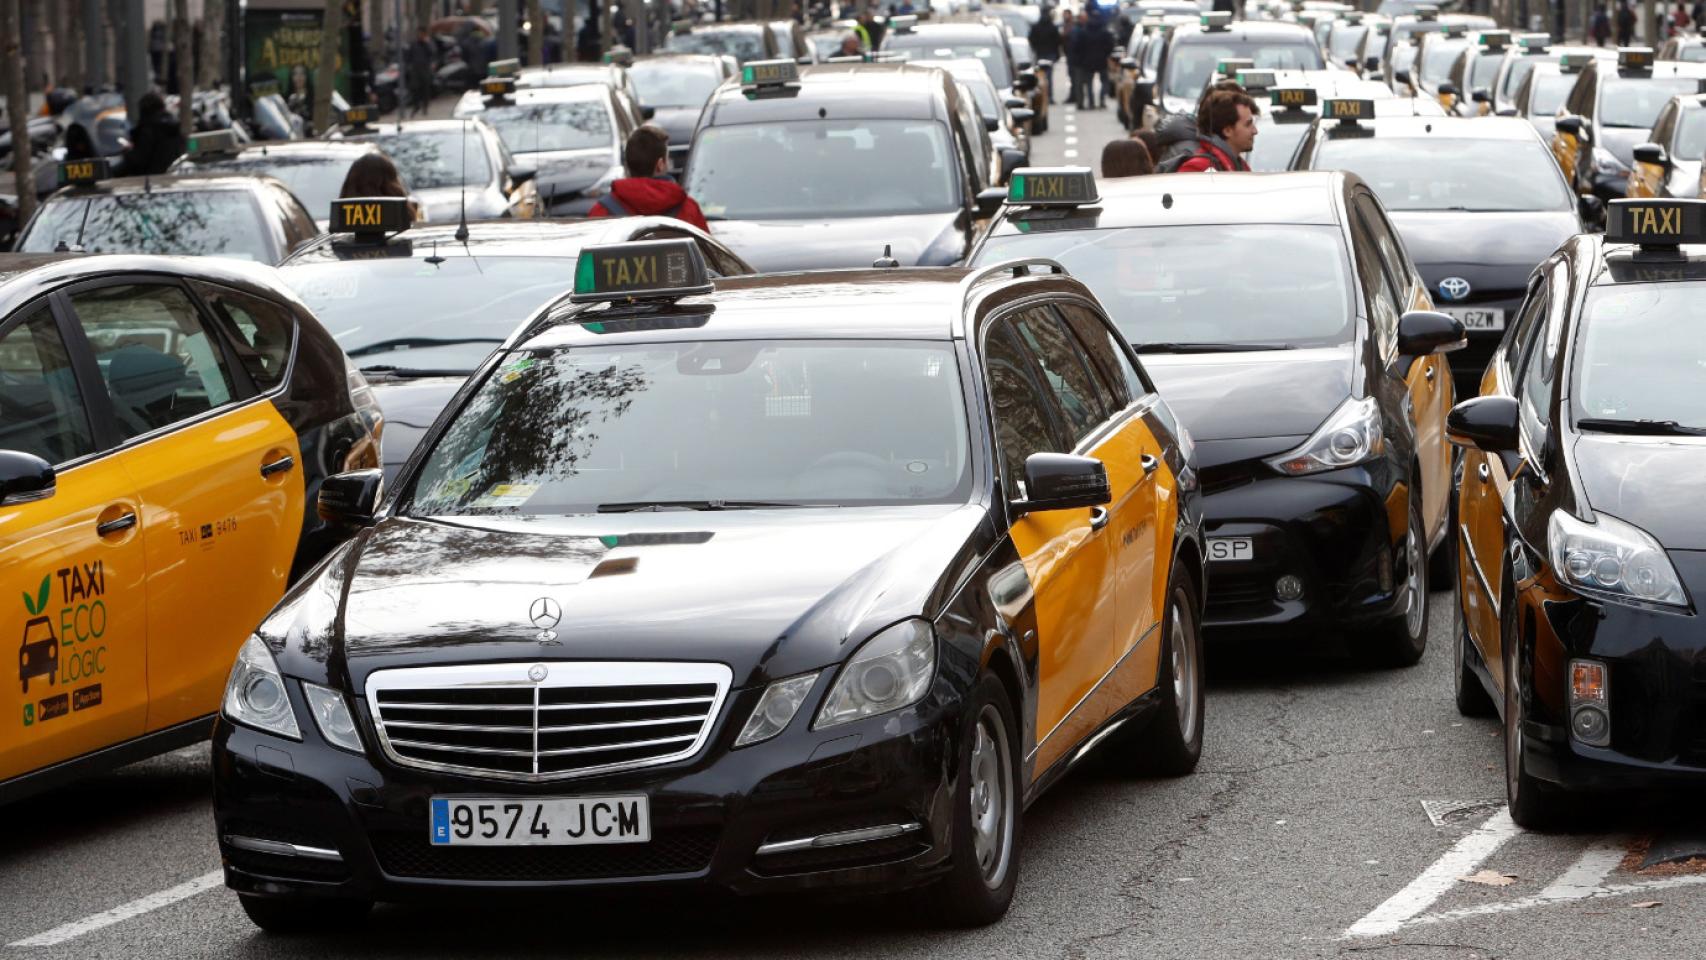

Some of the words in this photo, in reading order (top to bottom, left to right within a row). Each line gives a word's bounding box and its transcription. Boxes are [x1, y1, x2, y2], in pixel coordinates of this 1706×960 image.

[1280, 91, 1304, 103] TAXI
[1332, 102, 1360, 115] TAXI
[66, 162, 93, 178] TAXI
[1028, 176, 1065, 197] TAXI
[343, 204, 382, 225] TAXI
[1628, 207, 1681, 235] TAXI
[603, 255, 657, 285] TAXI
[1464, 311, 1494, 328] GZW
[179, 527, 198, 544] TAXI
[1212, 541, 1248, 558] SP
[57, 560, 104, 604] TAXI
[61, 600, 105, 646] ECO
[61, 646, 106, 683] LÒGIC
[452, 804, 550, 839] 9574
[566, 801, 639, 838] JCM
[437, 826, 445, 837] E
